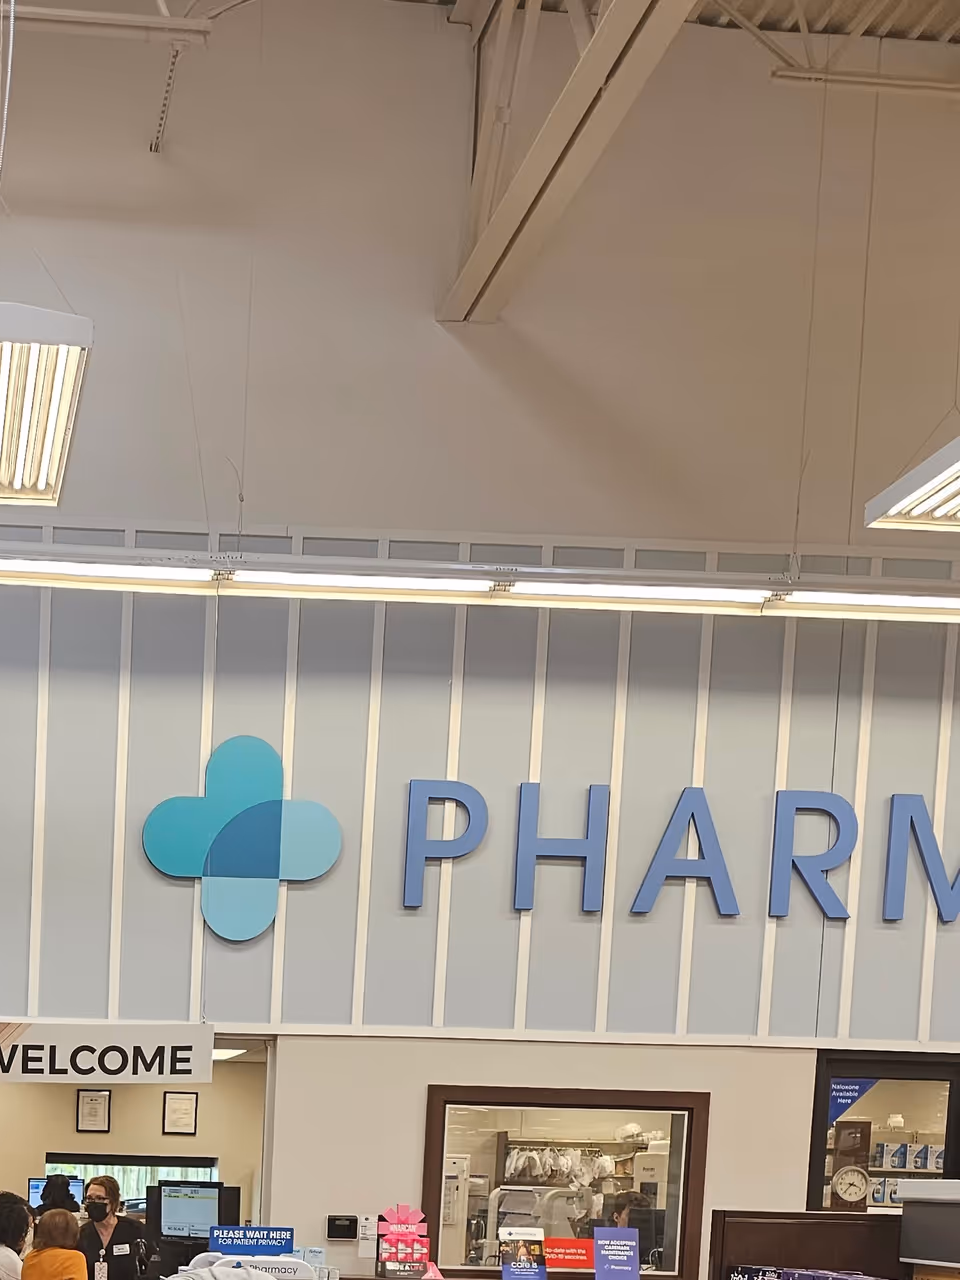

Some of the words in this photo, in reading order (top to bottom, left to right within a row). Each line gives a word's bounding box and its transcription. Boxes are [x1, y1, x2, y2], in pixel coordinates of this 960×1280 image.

[214, 1230, 244, 1238] PLEASE
[246, 1231, 268, 1239] WAIT
[270, 1231, 292, 1239] HERE
